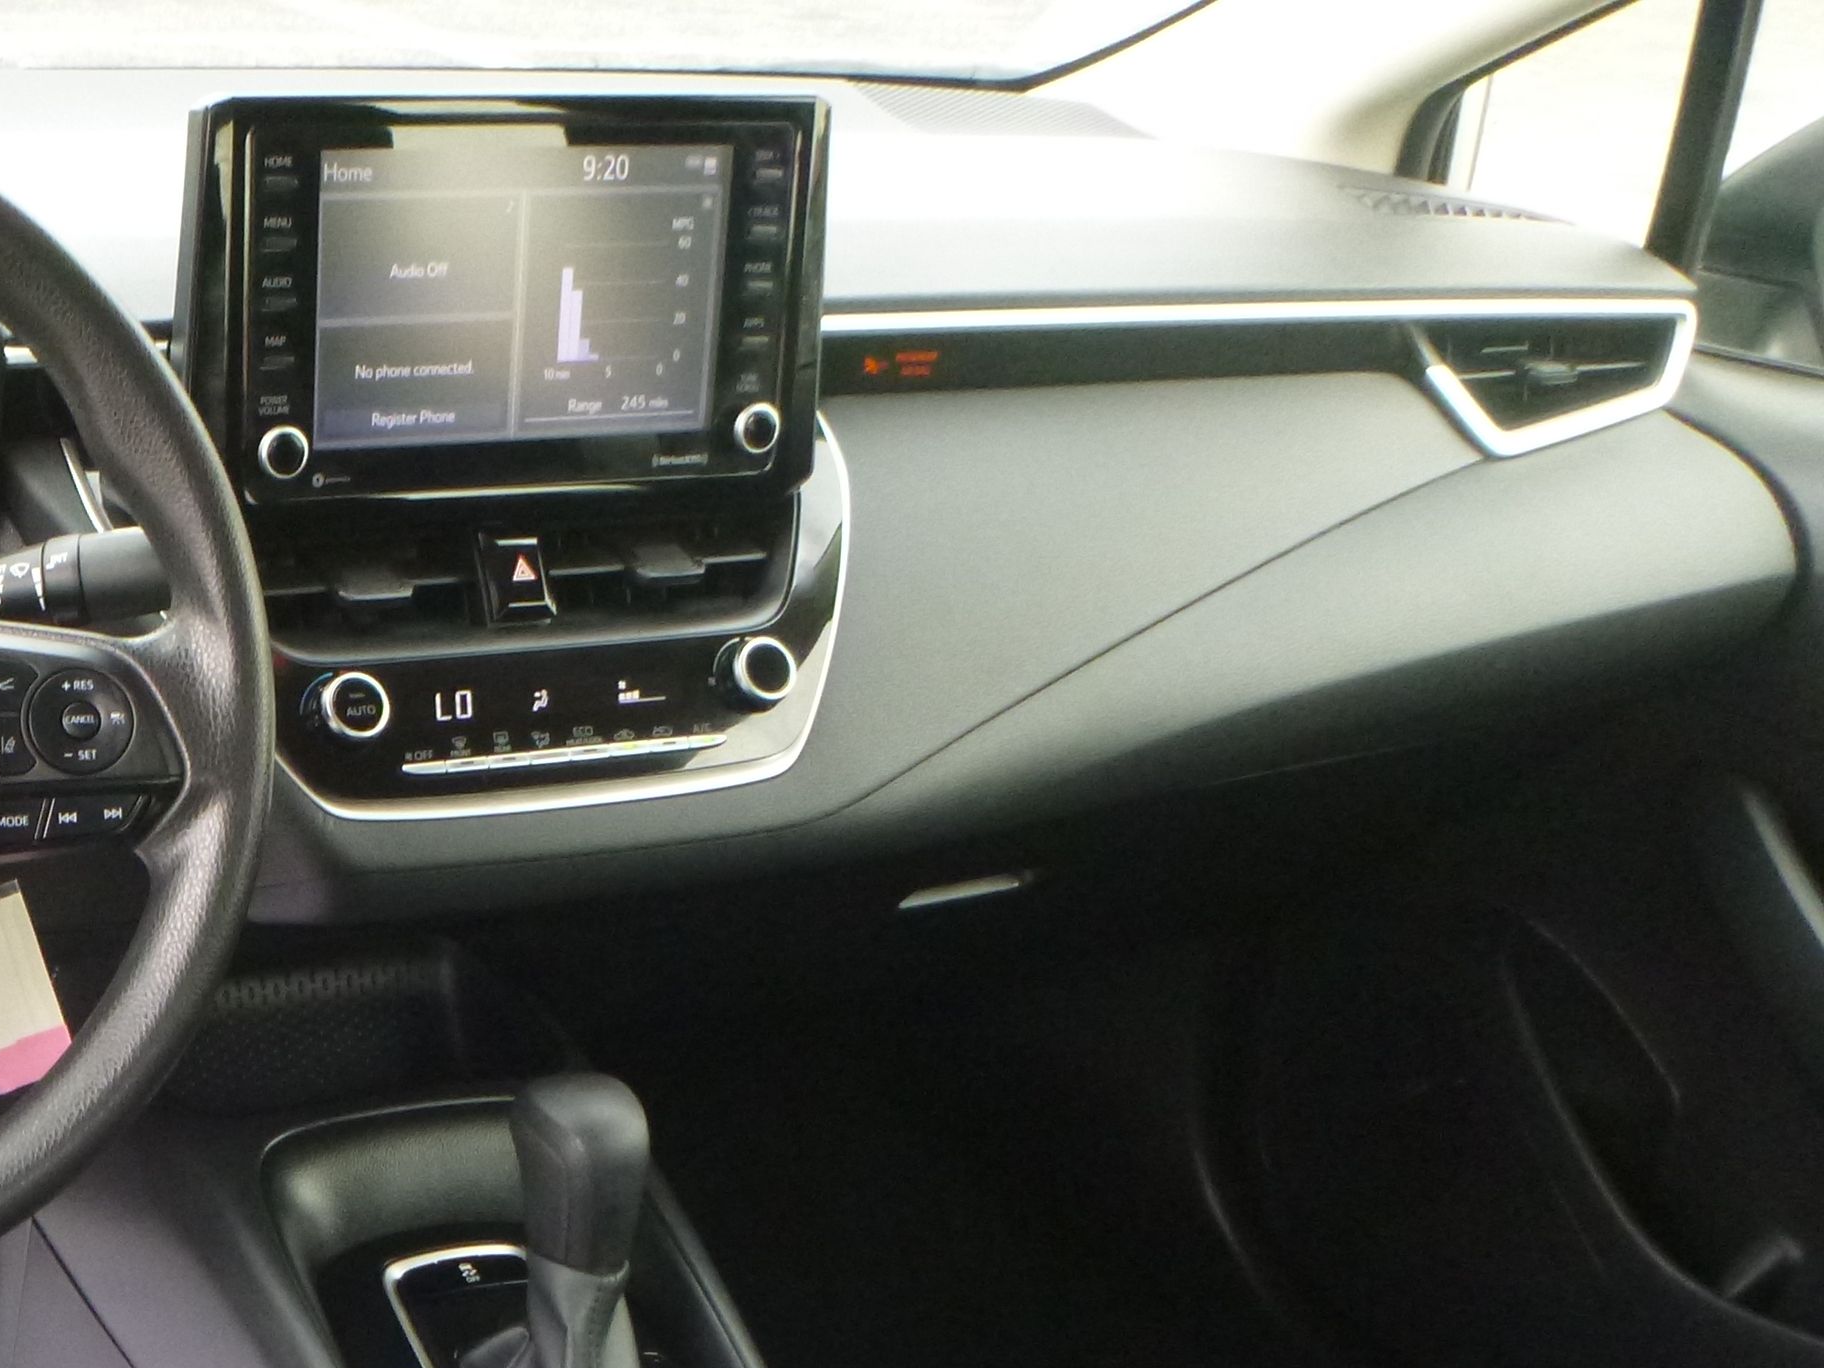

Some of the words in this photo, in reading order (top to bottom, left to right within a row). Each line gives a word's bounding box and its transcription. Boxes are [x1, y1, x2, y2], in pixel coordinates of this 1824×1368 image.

[264, 156, 293, 168] HOME
[583, 154, 630, 181] 9:20
[323, 162, 373, 182] Home
[263, 217, 292, 229] MENU
[678, 235, 692, 249] 60
[389, 263, 424, 279] Audio
[427, 262, 449, 277] Off
[261, 277, 292, 288] AUDIO
[676, 274, 689, 287] 40
[355, 364, 373, 379] No
[375, 364, 410, 381] phone
[544, 368, 555, 380] 10
[567, 398, 603, 415] Range
[621, 394, 646, 411] 245
[371, 412, 417, 430] Register
[420, 409, 455, 424] Phone
[73, 679, 94, 690] RES
[346, 704, 376, 717] AUTO
[435, 690, 473, 722] LO
[64, 714, 96, 725] CANCEL
[78, 749, 97, 761] SET
[414, 749, 434, 761] OFF
